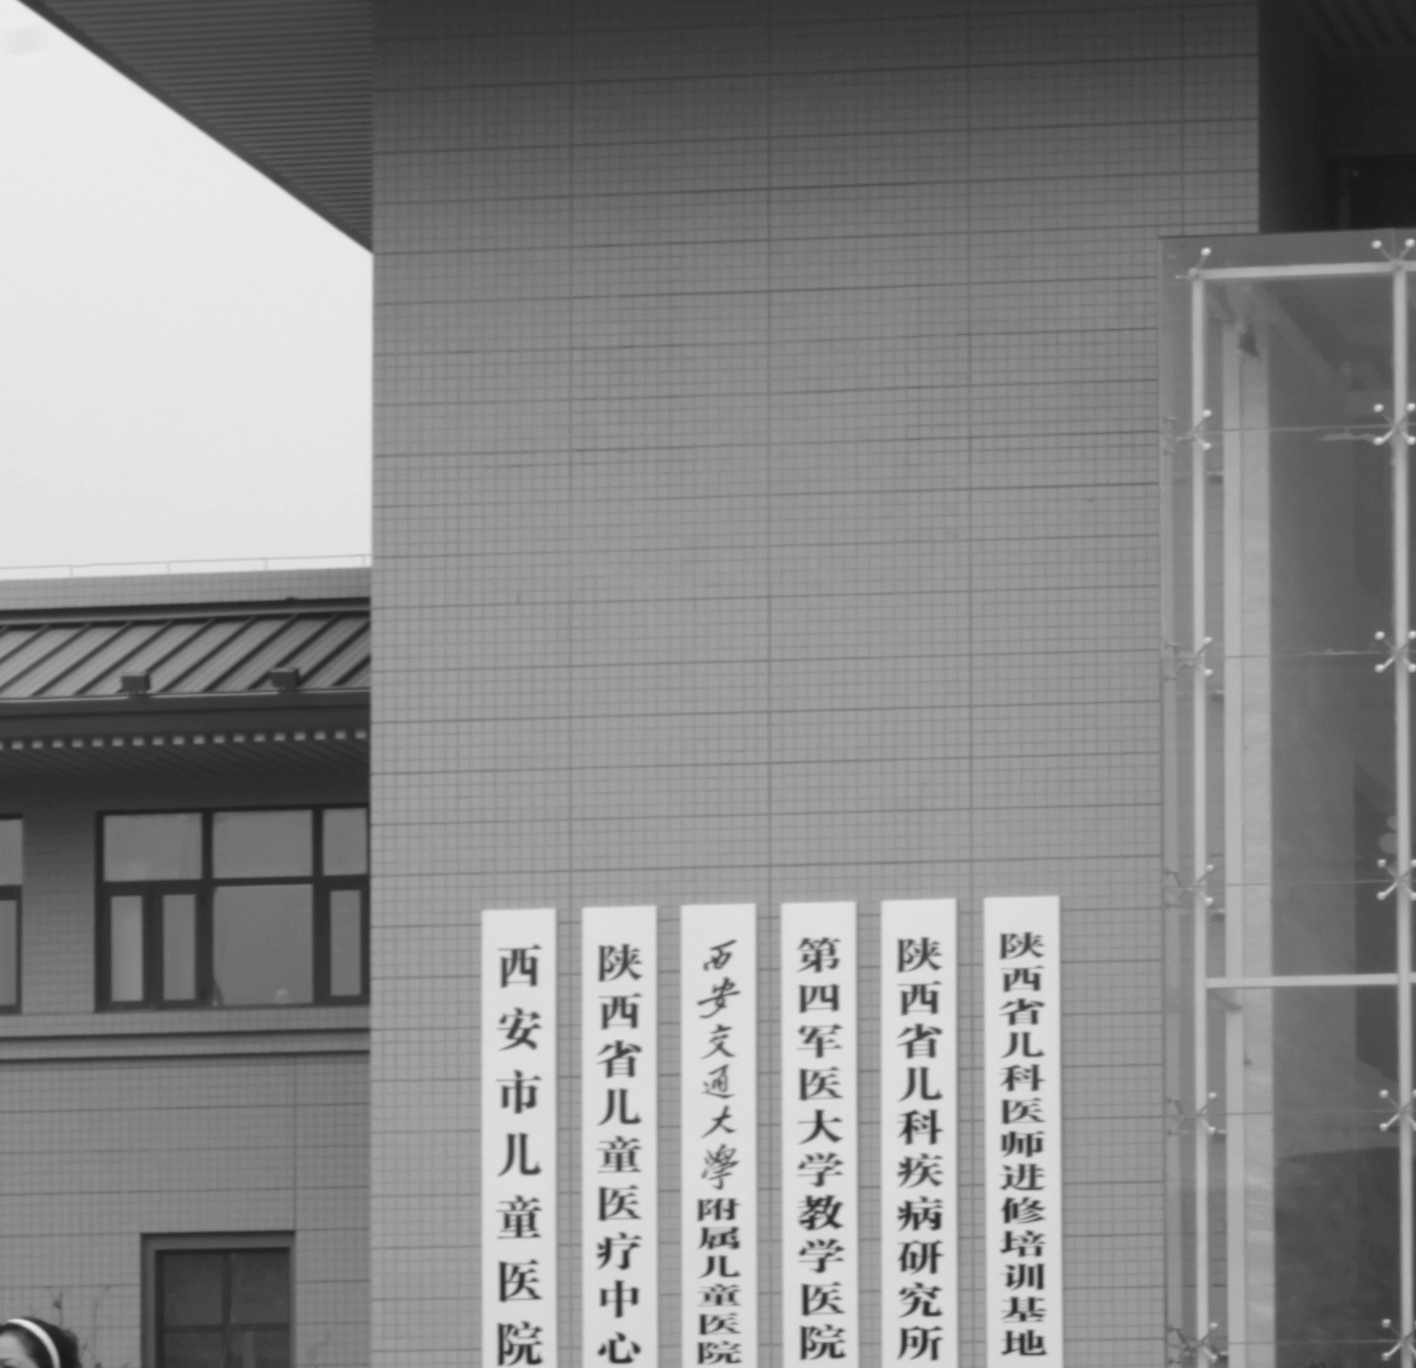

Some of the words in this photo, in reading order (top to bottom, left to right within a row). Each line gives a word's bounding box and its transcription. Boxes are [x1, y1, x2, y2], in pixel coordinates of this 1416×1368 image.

[496, 944, 544, 1367] 西安市儿童医院
[596, 943, 643, 1365] 陕西省儿童医疗中心
[796, 936, 847, 1361] 第四军医大学教学医院
[896, 936, 944, 1362] 陕西省儿科疾病研究所
[999, 931, 1048, 1357] 陕西省儿科医师进修培训基地
